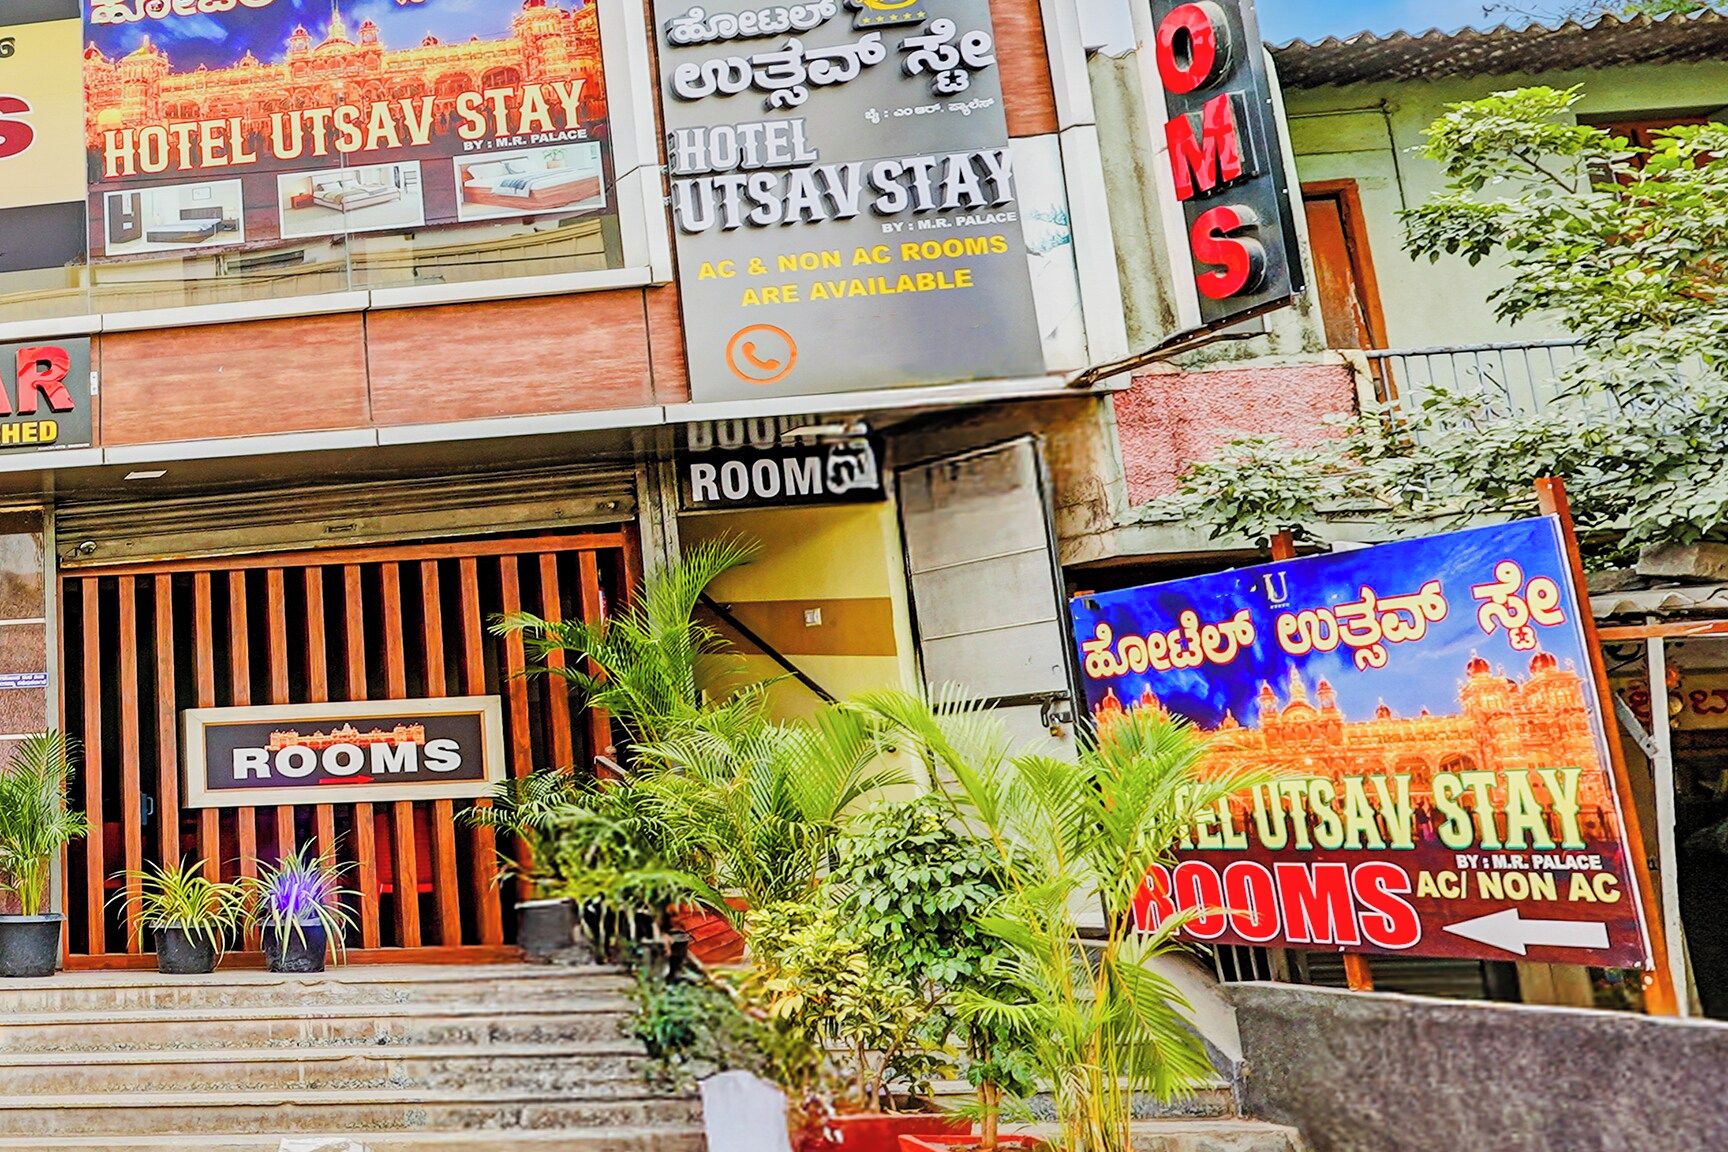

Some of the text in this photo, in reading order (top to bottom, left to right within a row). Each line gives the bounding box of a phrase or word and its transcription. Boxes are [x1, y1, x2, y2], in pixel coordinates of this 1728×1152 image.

[102, 79, 587, 179] HOTEL UTSAV STAY
[463, 140, 484, 151] BY
[496, 137, 527, 148] M.R.
[531, 129, 588, 144] PALACE
[675, 119, 818, 174] HOTEL
[673, 149, 1016, 233] UTSAV STAY
[882, 222, 904, 233] BY
[918, 218, 953, 230] M.R.
[955, 211, 1017, 226] PALACE
[698, 234, 1008, 280] AC & NON AC ROOMS
[741, 268, 974, 307] ARE AVAILABLE
[232, 738, 462, 780] ROOMS
[1252, 774, 1415, 851] UTSAV
[1432, 767, 1587, 851] STAY
[1456, 854, 1479, 869] BY
[1492, 855, 1529, 869] M.R.
[1532, 854, 1603, 870] PALACE
[1132, 860, 1421, 949] ROOMS
[1476, 871, 1558, 901] NON
[1569, 873, 1621, 903] AC
